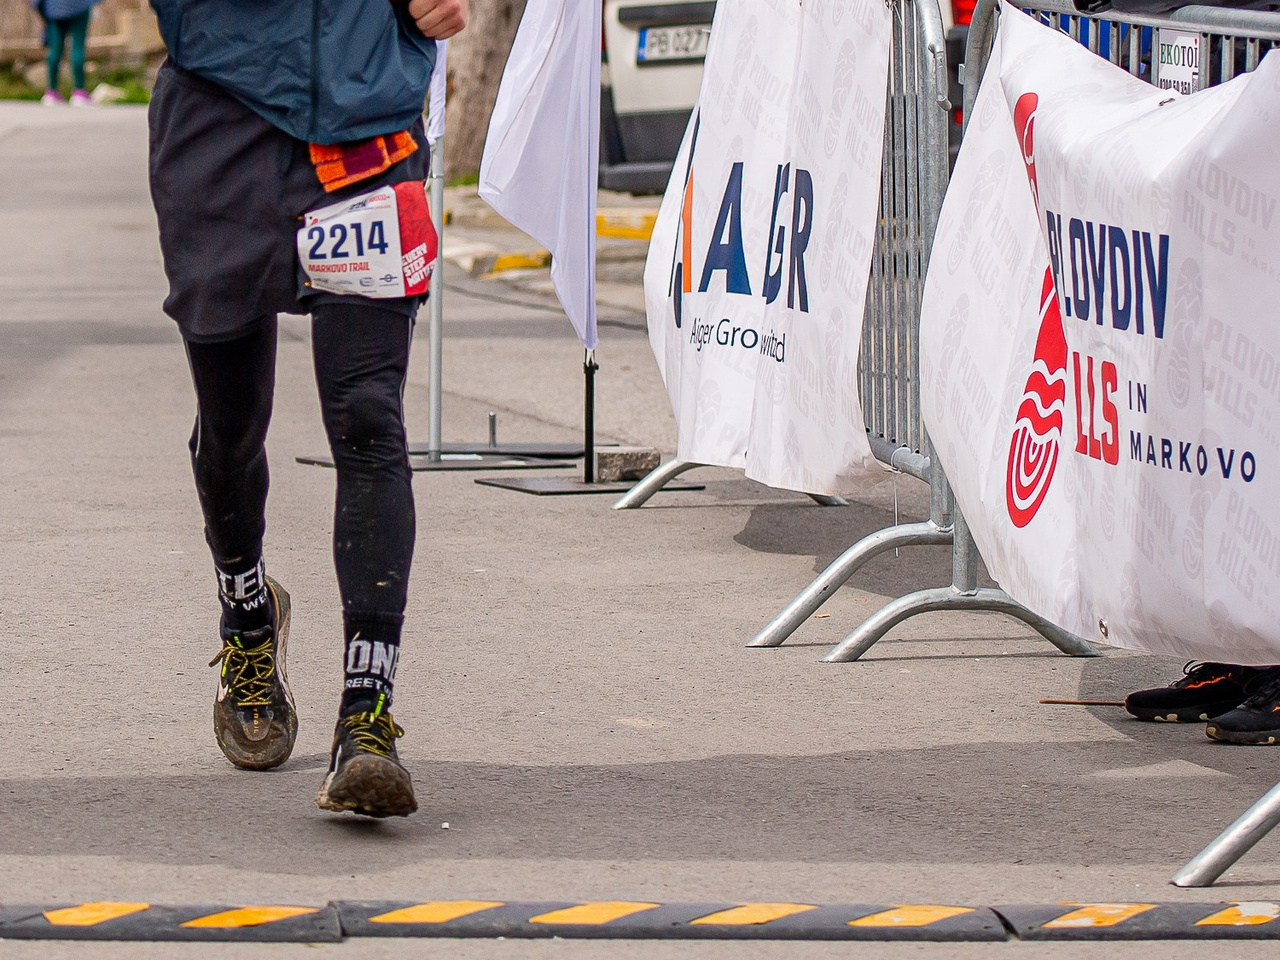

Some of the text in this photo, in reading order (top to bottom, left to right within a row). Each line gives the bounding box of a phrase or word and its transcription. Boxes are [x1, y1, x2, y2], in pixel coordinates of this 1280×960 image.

[307, 221, 389, 260] 2214
[308, 261, 370, 273] MARKOVO TRAIL
[403, 256, 426, 277] STEP
[716, 319, 758, 348] Gro
[1204, 316, 1280, 404] PLOVDI
[1072, 351, 1119, 466] LLS
[1128, 380, 1147, 413] IN
[1130, 430, 1256, 483] MARKOVO
